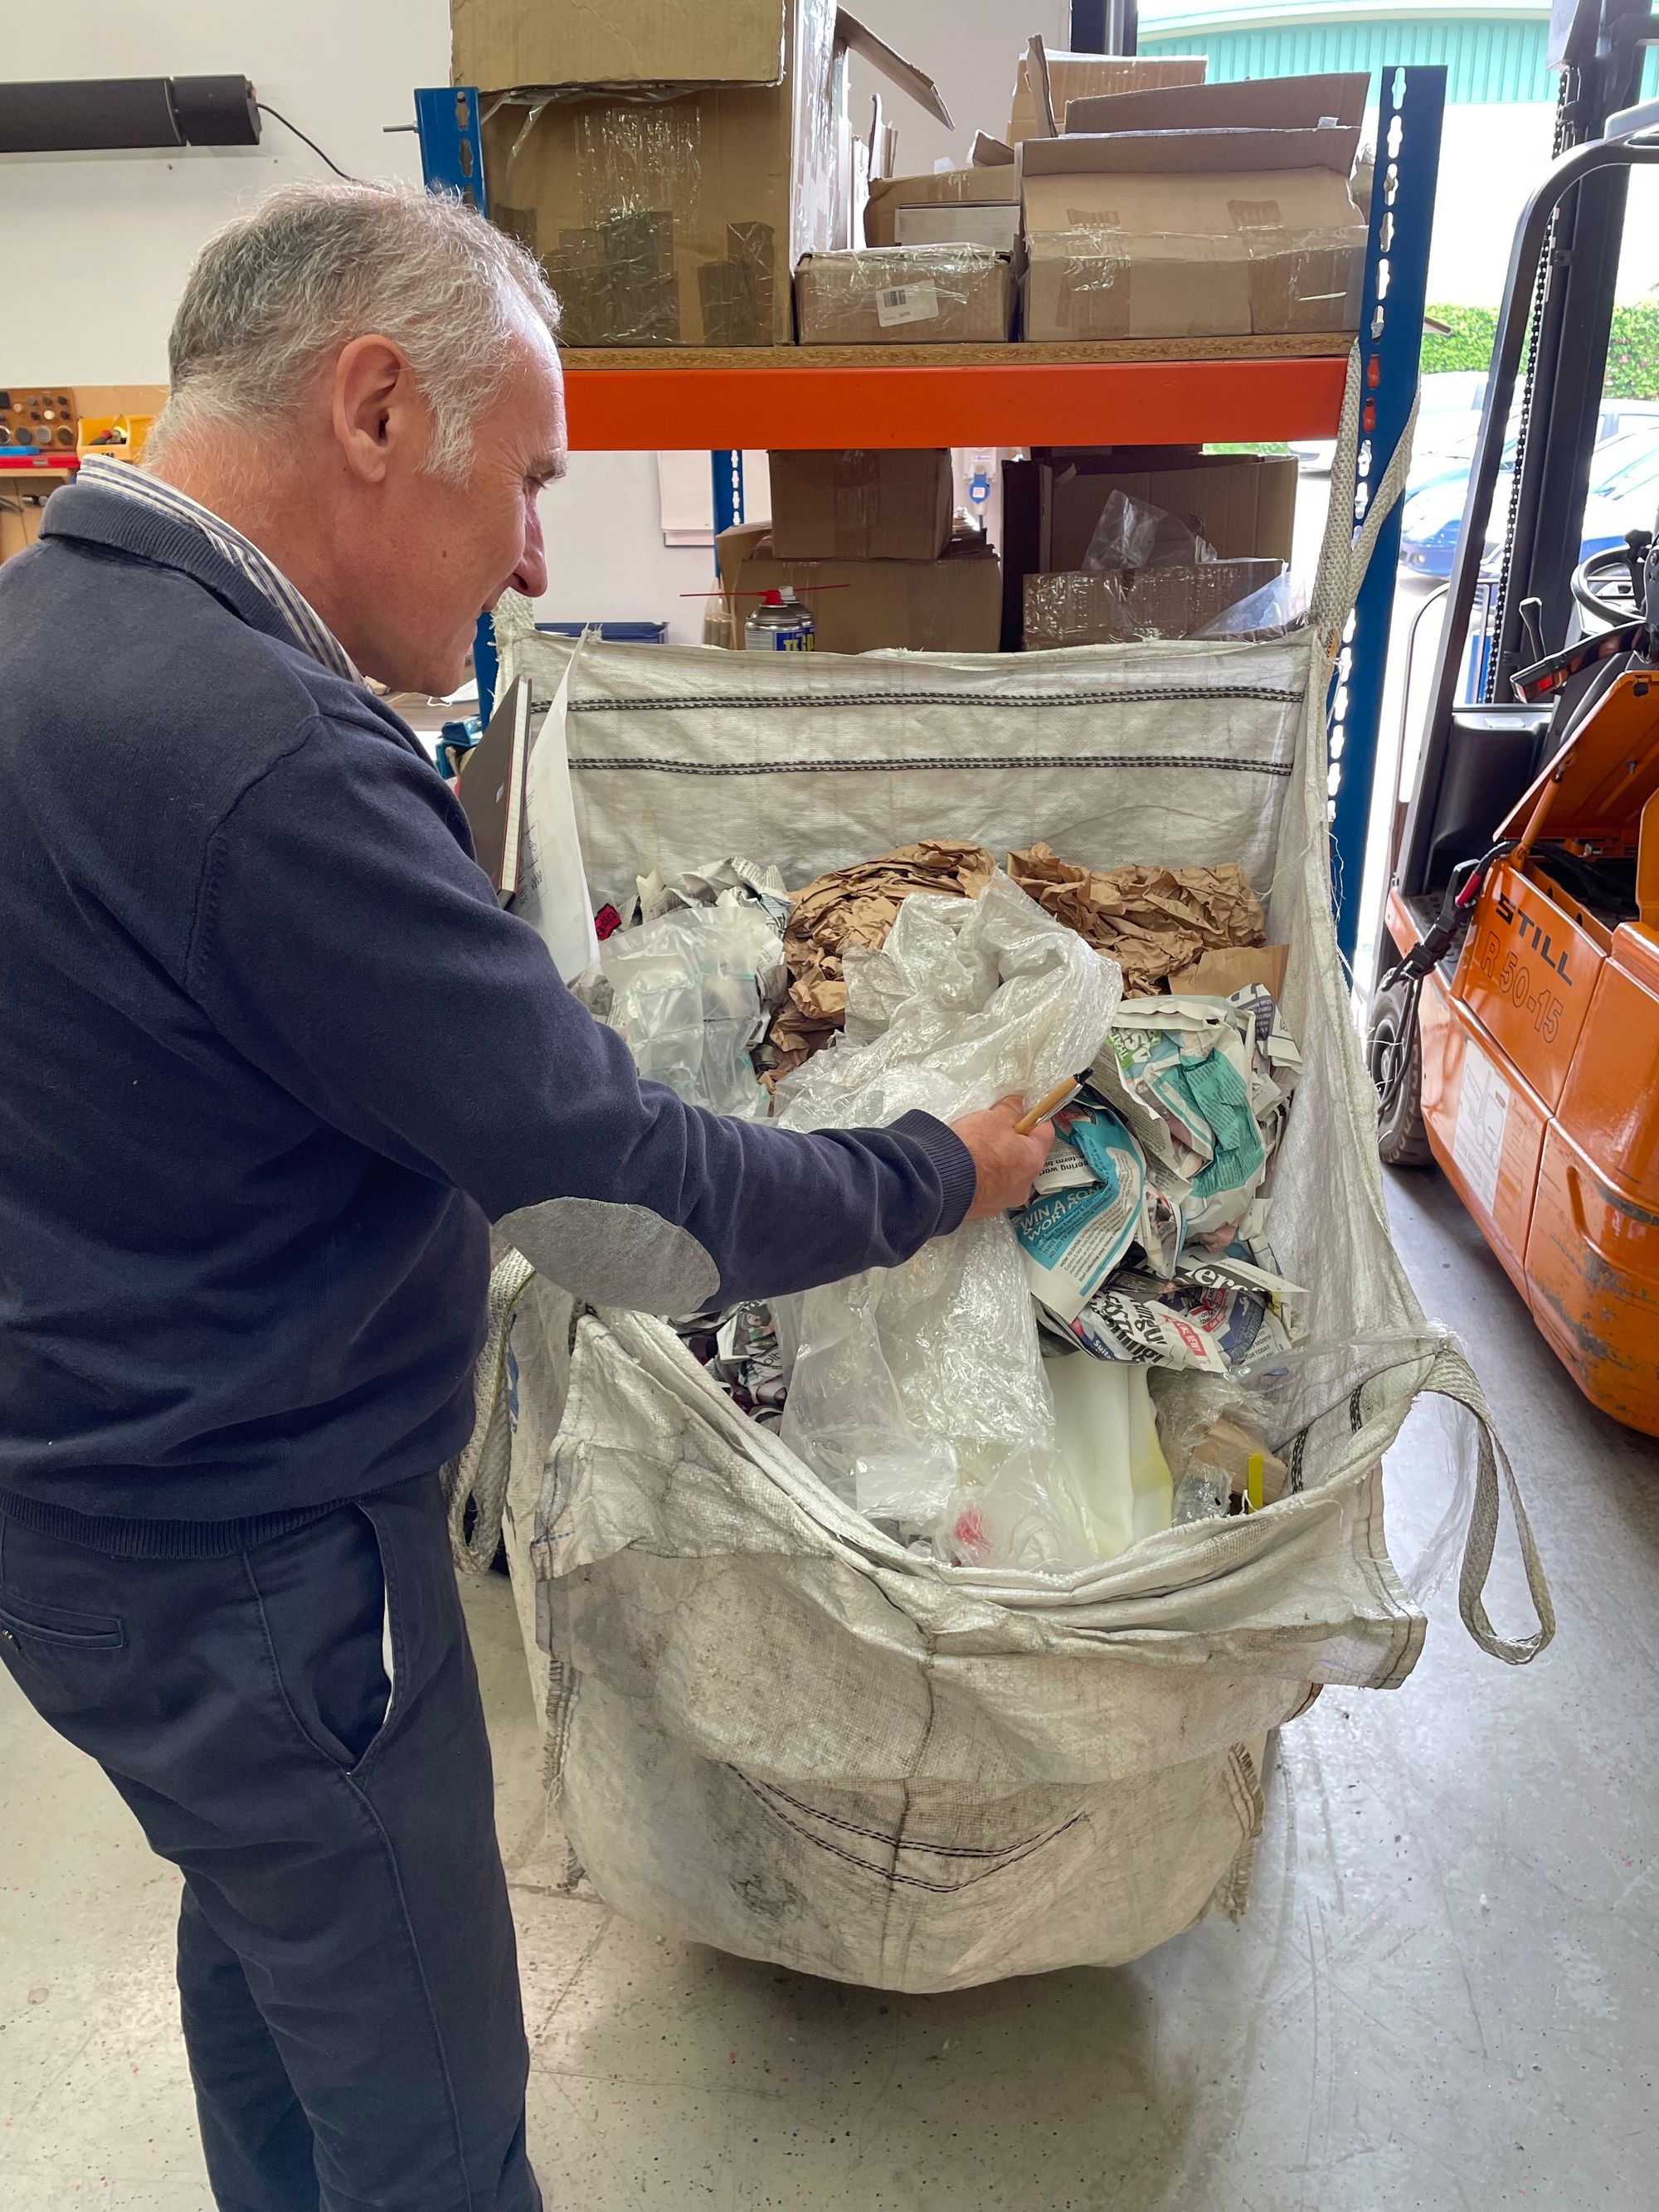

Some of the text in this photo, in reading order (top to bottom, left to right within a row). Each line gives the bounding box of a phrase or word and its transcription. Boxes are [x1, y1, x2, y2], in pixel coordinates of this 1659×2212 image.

[1481, 931, 1564, 1043] R 50-15
[1496, 892, 1573, 987] STILL
[1020, 1205, 1050, 1232] WIN
